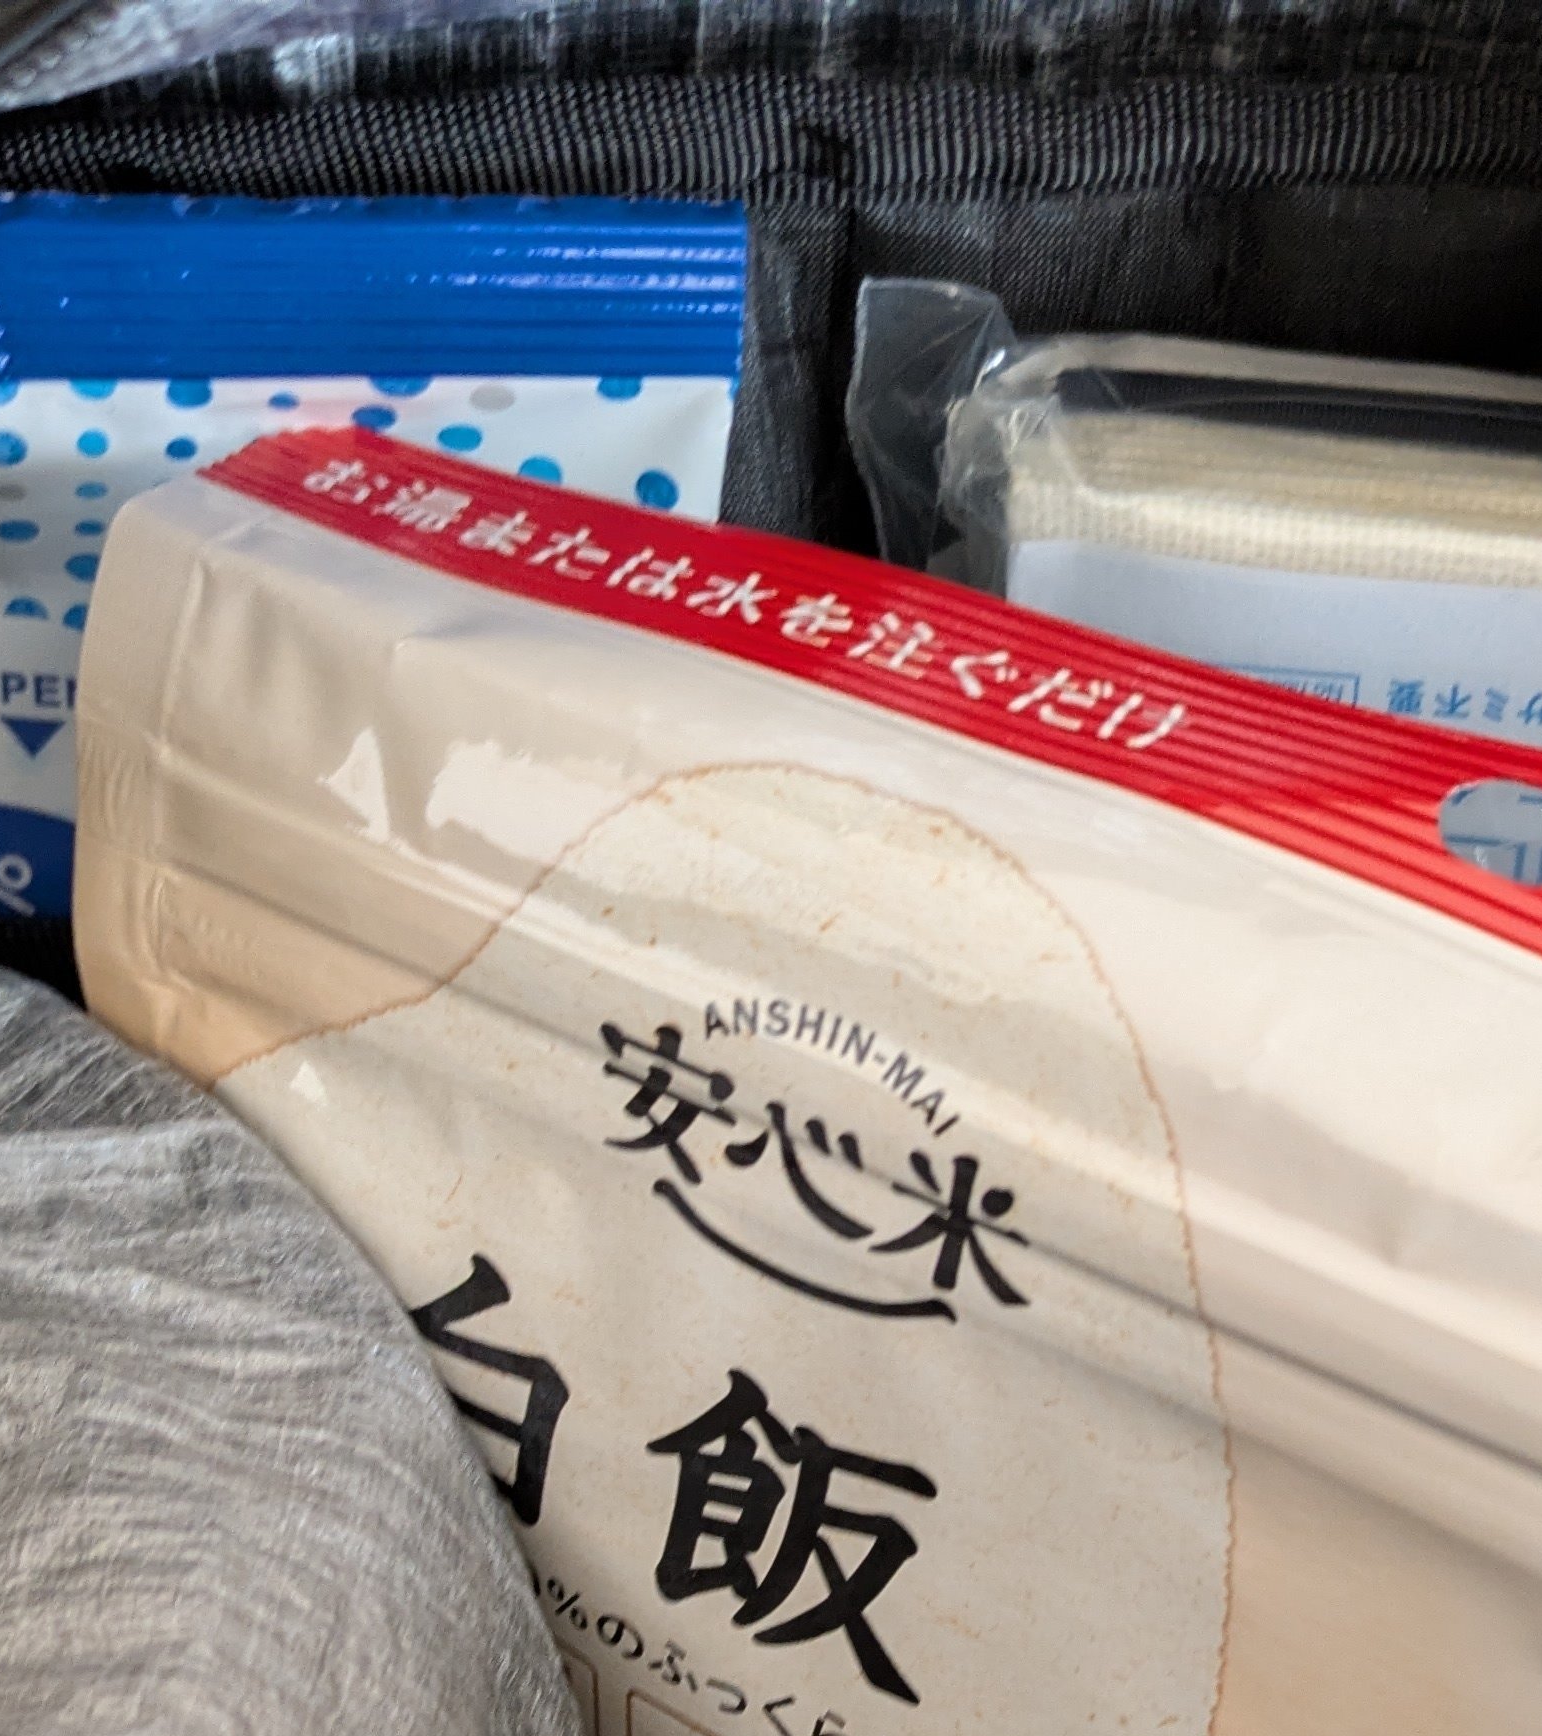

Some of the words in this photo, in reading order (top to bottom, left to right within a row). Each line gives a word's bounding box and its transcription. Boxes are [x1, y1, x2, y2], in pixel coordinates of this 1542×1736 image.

[303, 458, 1189, 751] お湯または水を注ぐだけ
[599, 1020, 1032, 1306] 安心米
[704, 998, 961, 1138] ANSHIN-MAI
